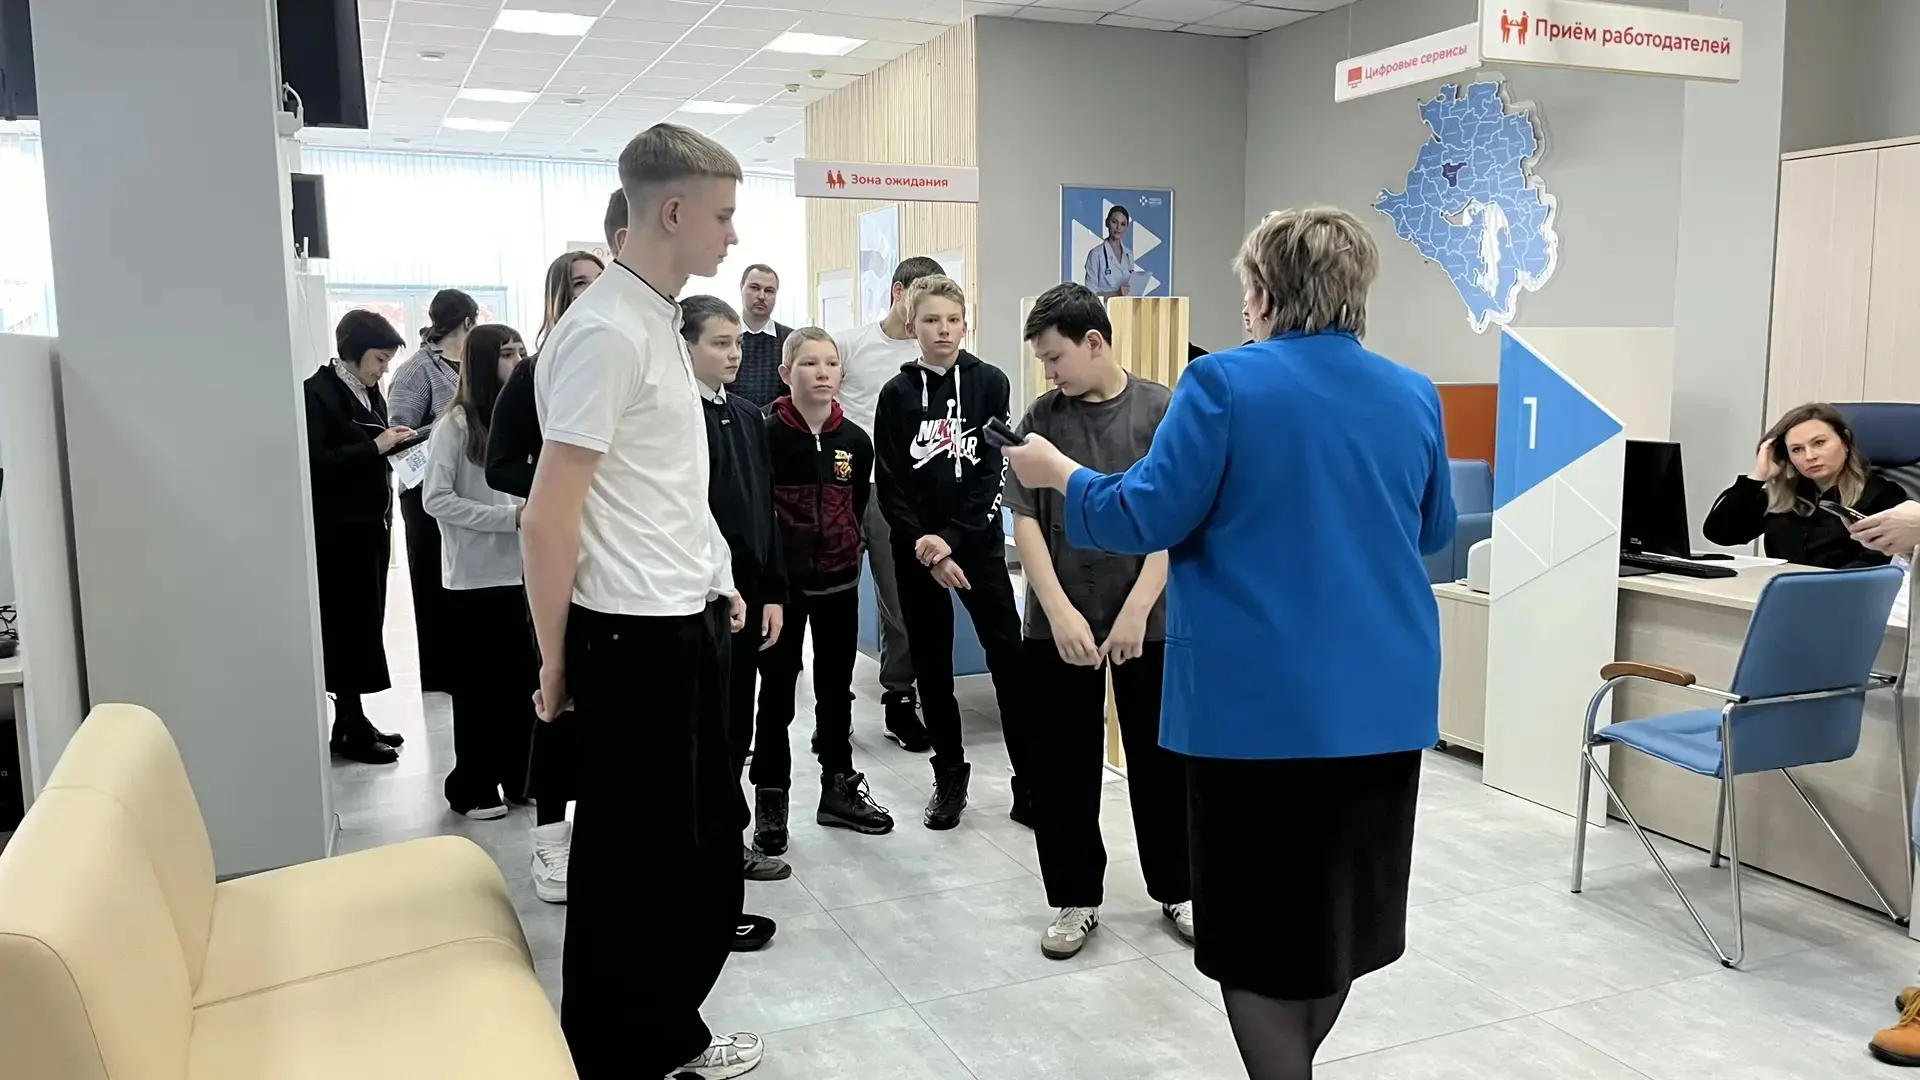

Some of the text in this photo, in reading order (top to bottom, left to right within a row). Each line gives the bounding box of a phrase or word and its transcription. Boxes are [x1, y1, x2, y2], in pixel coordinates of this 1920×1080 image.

[1535, 18, 1731, 54] Приём работодателей
[1365, 44, 1468, 79] Цифровые сервисы
[851, 173, 948, 188] Зона ожидания
[917, 418, 963, 442] NIKE
[1522, 396, 1538, 450] 1
[947, 436, 978, 459] AIR
